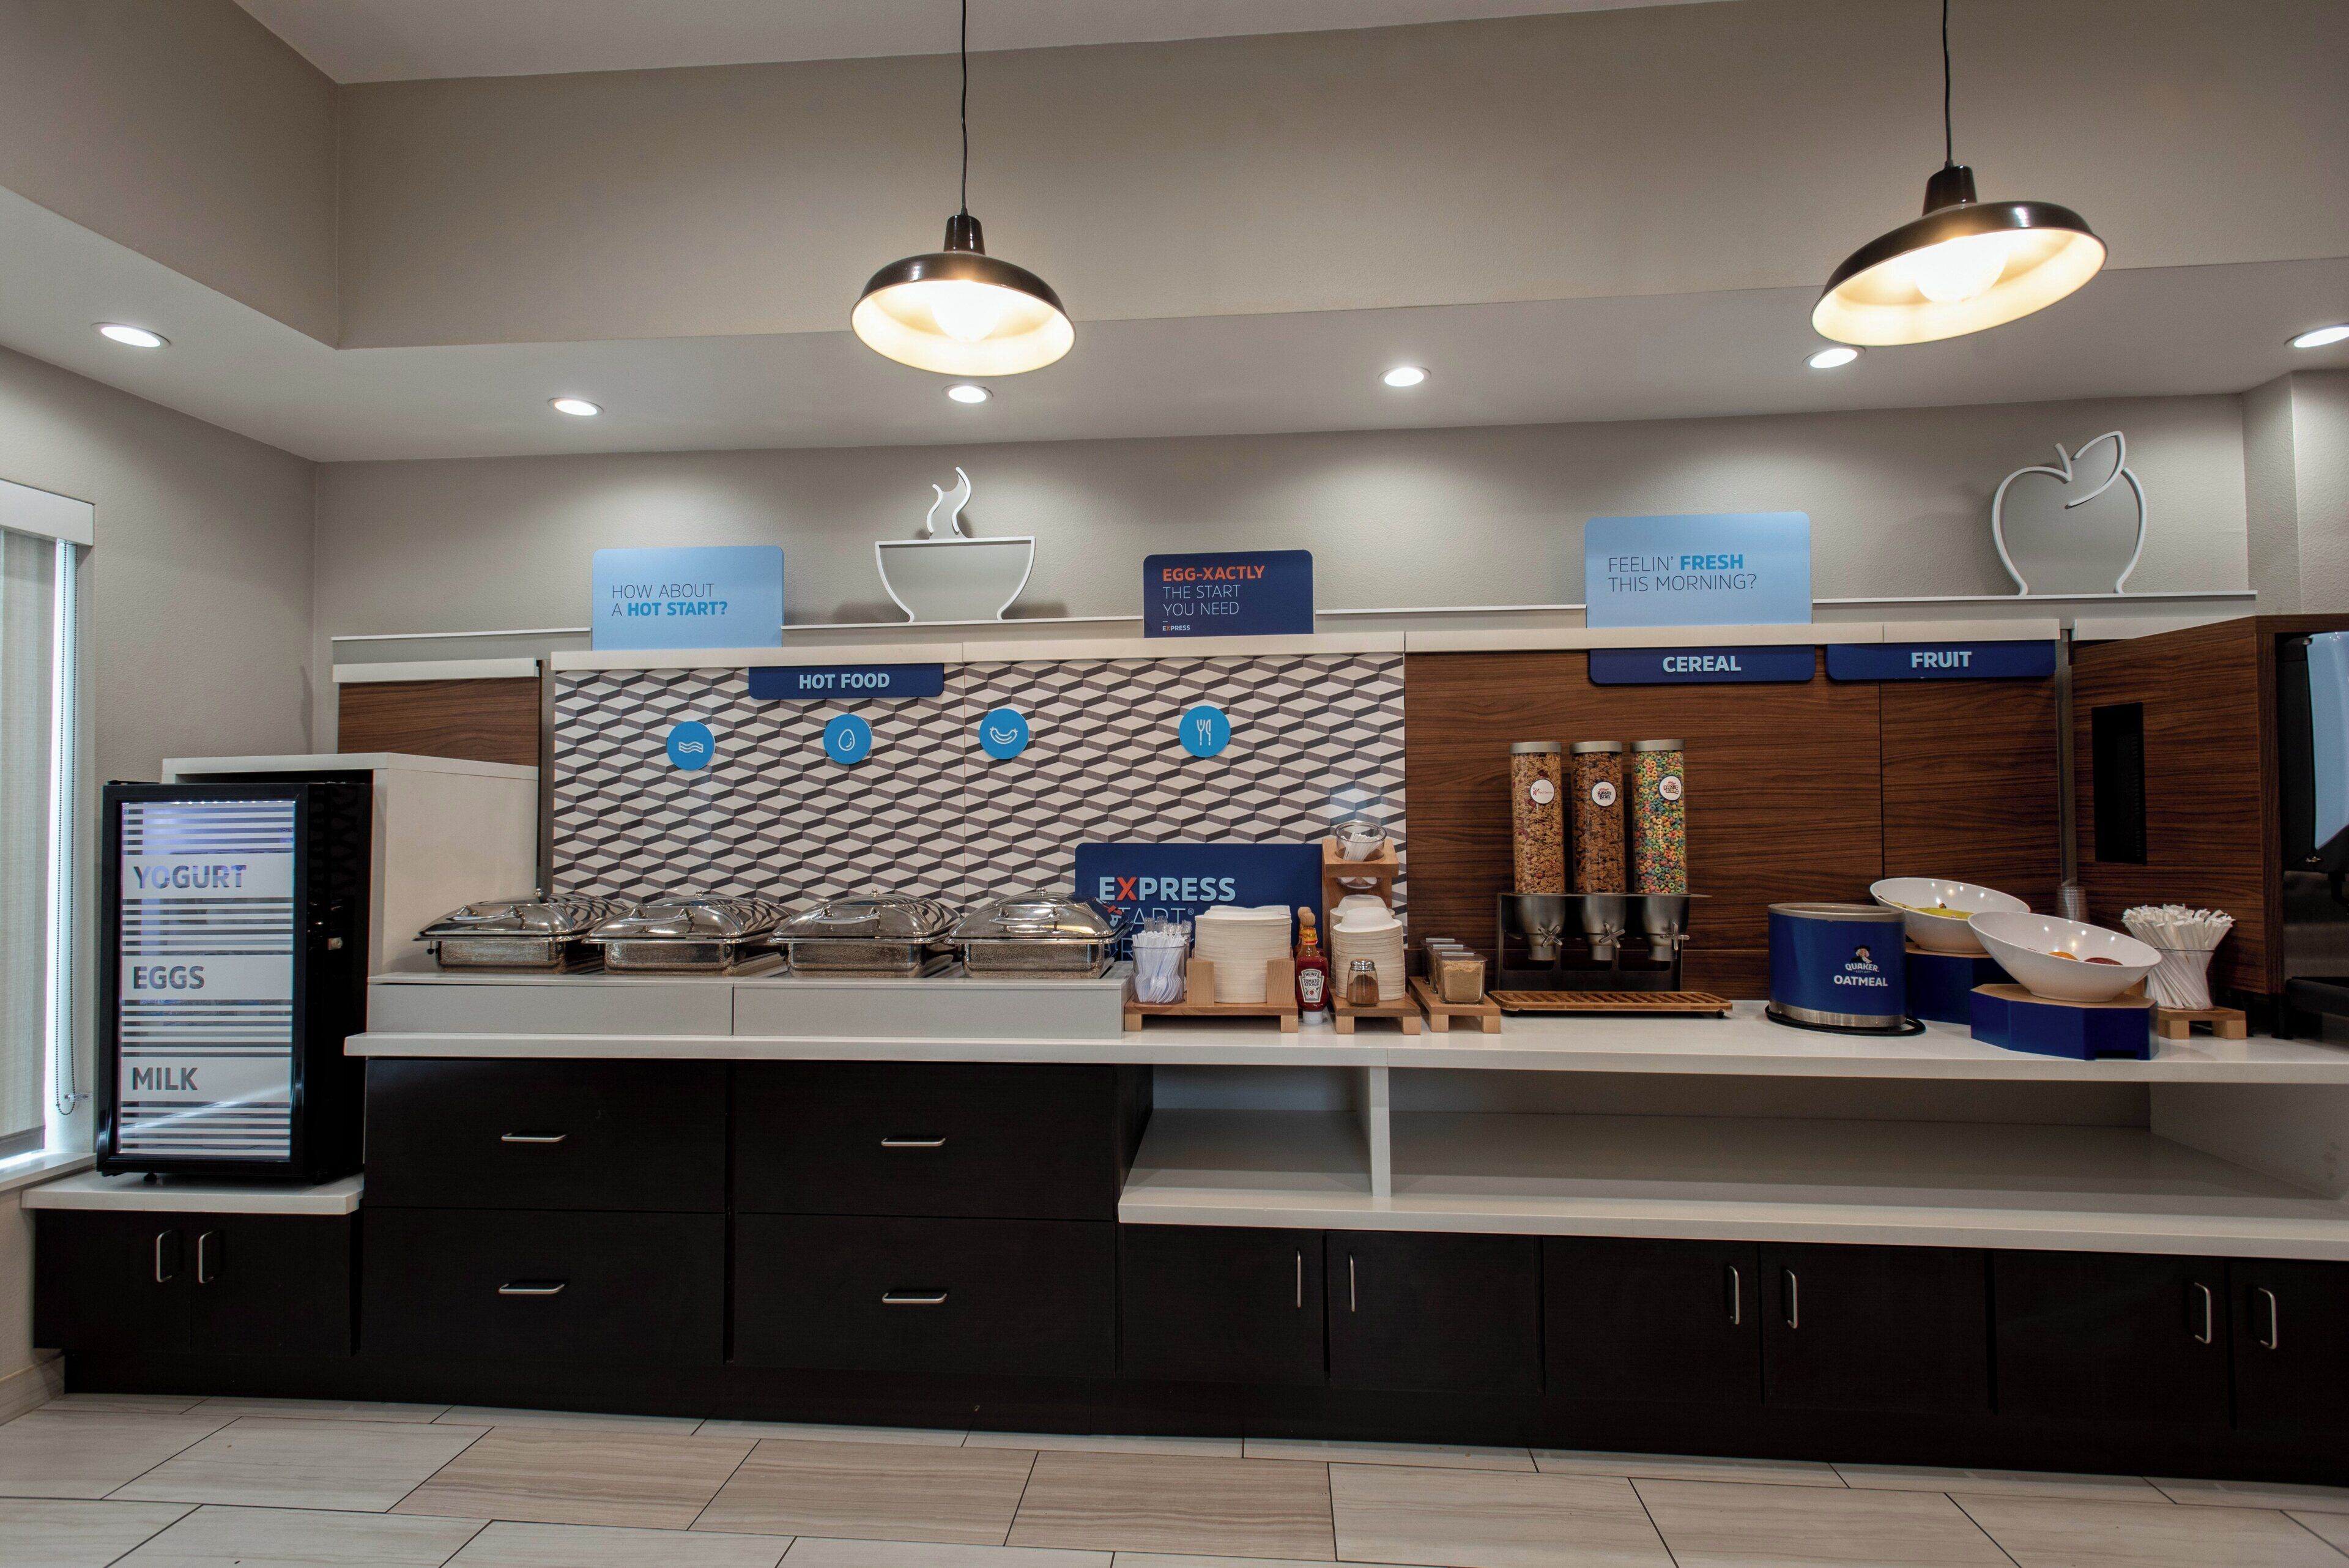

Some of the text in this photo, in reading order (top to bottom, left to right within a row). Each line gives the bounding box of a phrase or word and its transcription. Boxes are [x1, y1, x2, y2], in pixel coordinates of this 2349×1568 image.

[1608, 553, 1743, 573] FEELIN' FRESH
[1162, 565, 1266, 582] EGG-XACTLY
[1608, 573, 1756, 592] THIS MORNING?
[612, 582, 714, 600] HOW ABOUT
[1162, 584, 1241, 600] THE START
[612, 601, 728, 617] A HOT START?
[1162, 601, 1239, 617] YOU NEED
[1663, 655, 1742, 674] CEREAL
[1911, 651, 1972, 669] FRUIT
[798, 672, 890, 689] HOT FOOD
[133, 864, 248, 890] YOGURT
[1099, 877, 1236, 902] EXPRESS
[1845, 963, 1879, 972] QUAKER
[133, 965, 206, 990] EGGS
[1833, 975, 1888, 987] OATMEAL
[133, 1066, 199, 1091] MILK
